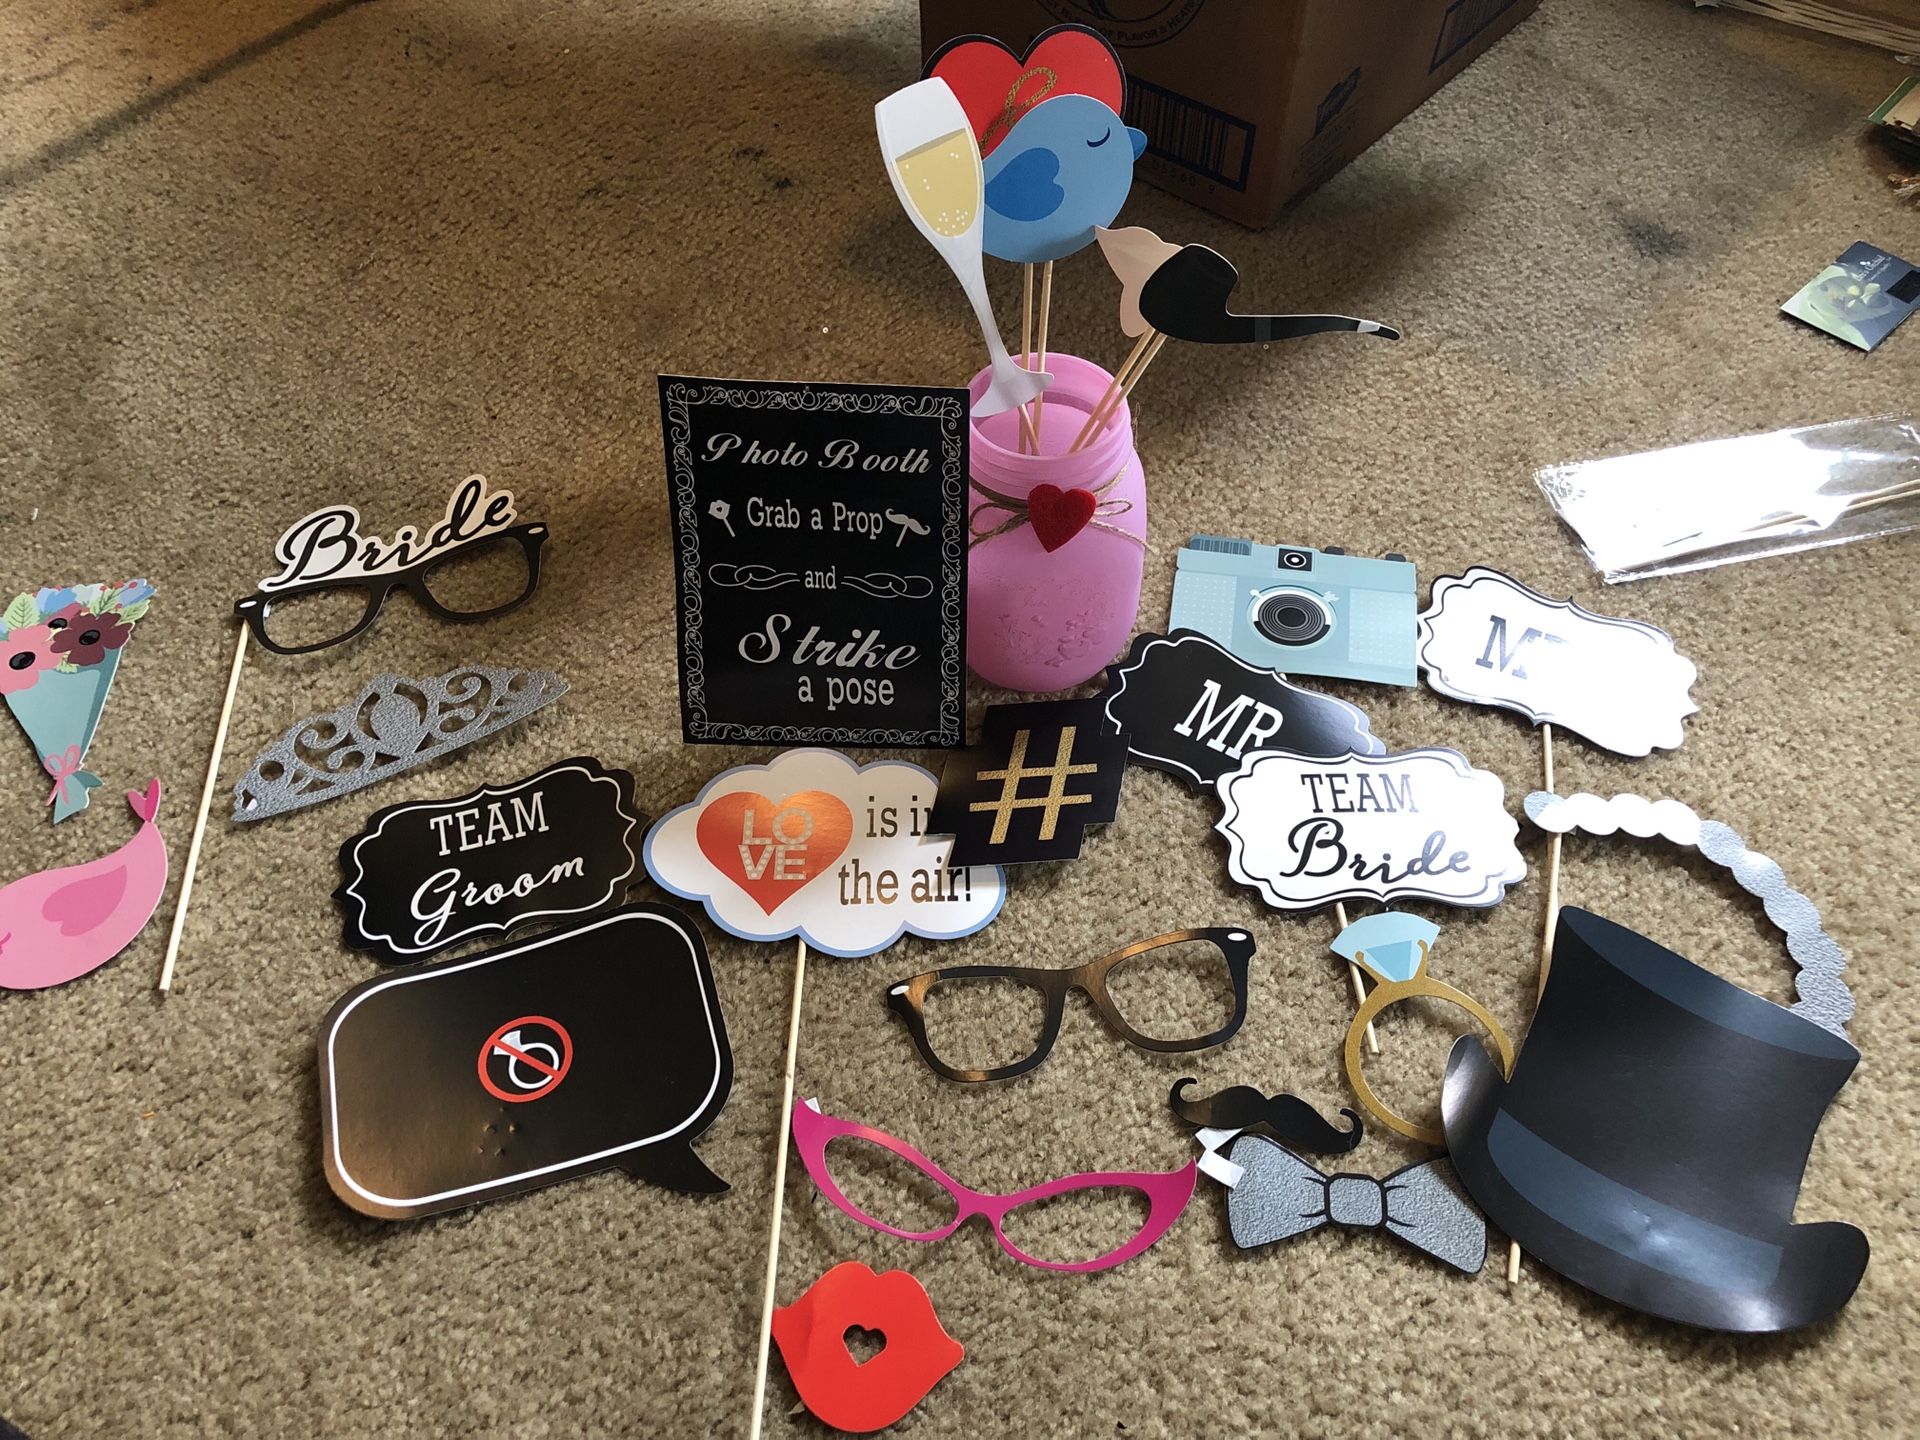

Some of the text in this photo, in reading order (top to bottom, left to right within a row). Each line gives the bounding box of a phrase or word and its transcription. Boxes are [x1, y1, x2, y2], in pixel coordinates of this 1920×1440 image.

[701, 433, 932, 474] Photo Booth
[266, 479, 512, 588] Bride
[747, 496, 884, 540] Grab a Prop
[804, 565, 837, 590] and
[738, 613, 922, 670] Strike
[797, 675, 895, 711] a pose
[1173, 679, 1284, 760] MR
[866, 795, 898, 838] is
[1301, 772, 1420, 815] TEAM
[429, 791, 550, 856] TEAM
[1279, 816, 1470, 885] Bride
[410, 857, 585, 947] Groom
[838, 855, 971, 905] the air!
